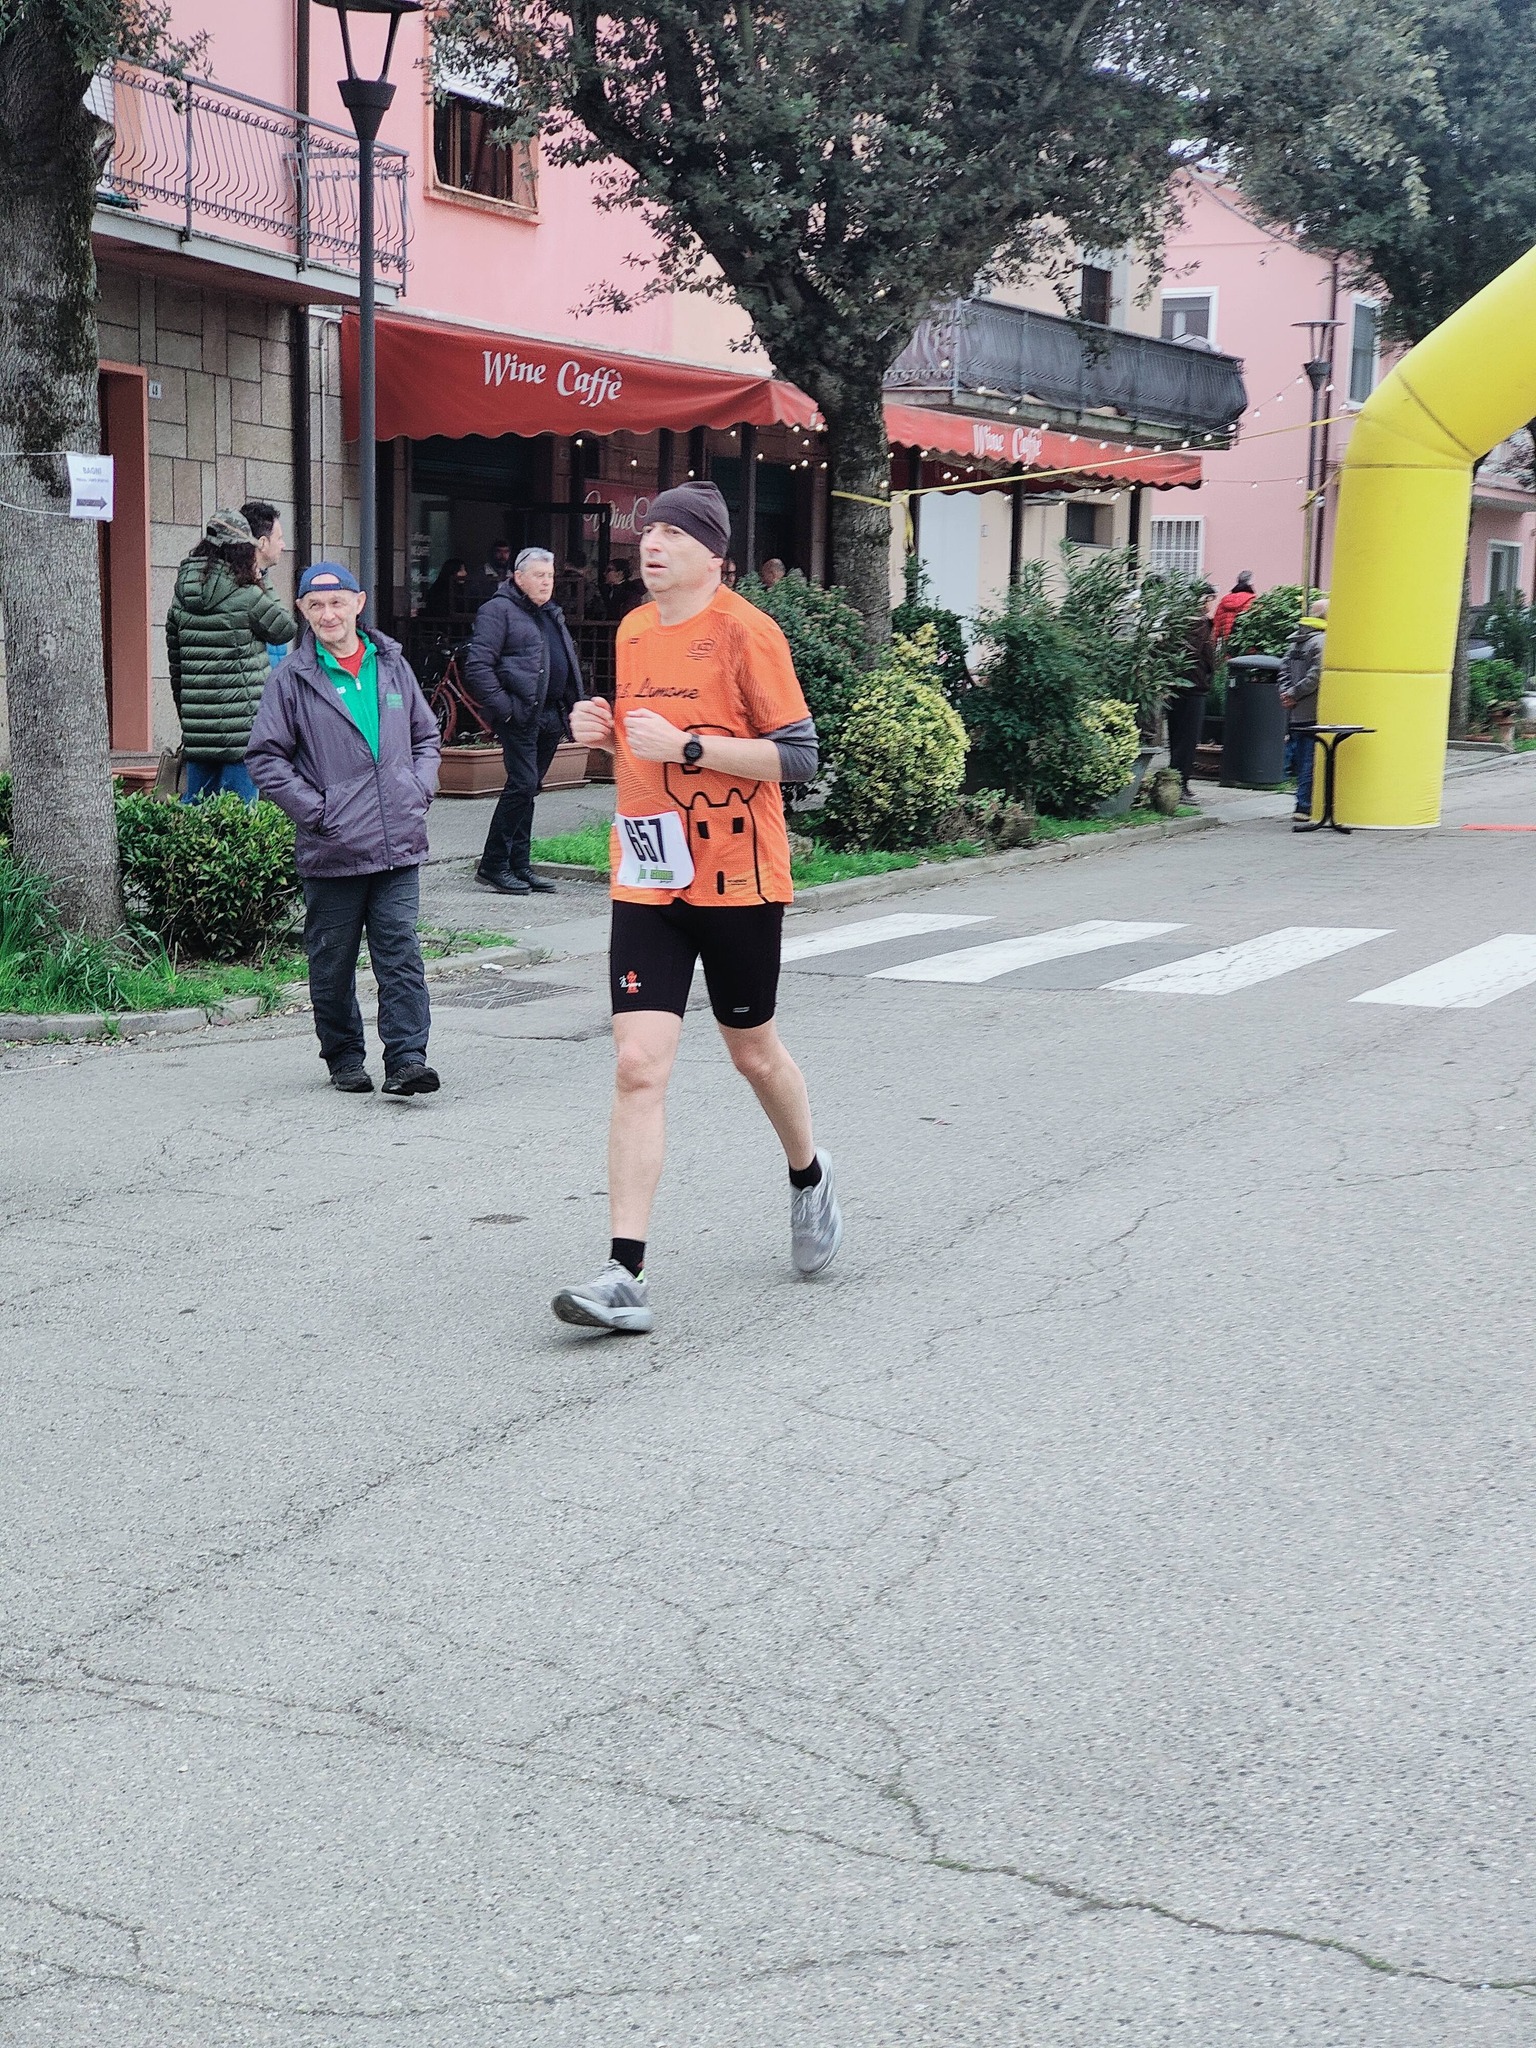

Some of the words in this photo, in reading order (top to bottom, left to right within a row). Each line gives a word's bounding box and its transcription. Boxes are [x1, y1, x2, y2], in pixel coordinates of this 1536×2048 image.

[482, 350, 547, 387] Wine
[556, 360, 623, 407] Caffè
[973, 424, 1005, 459] Wine
[624, 818, 667, 863] 657
